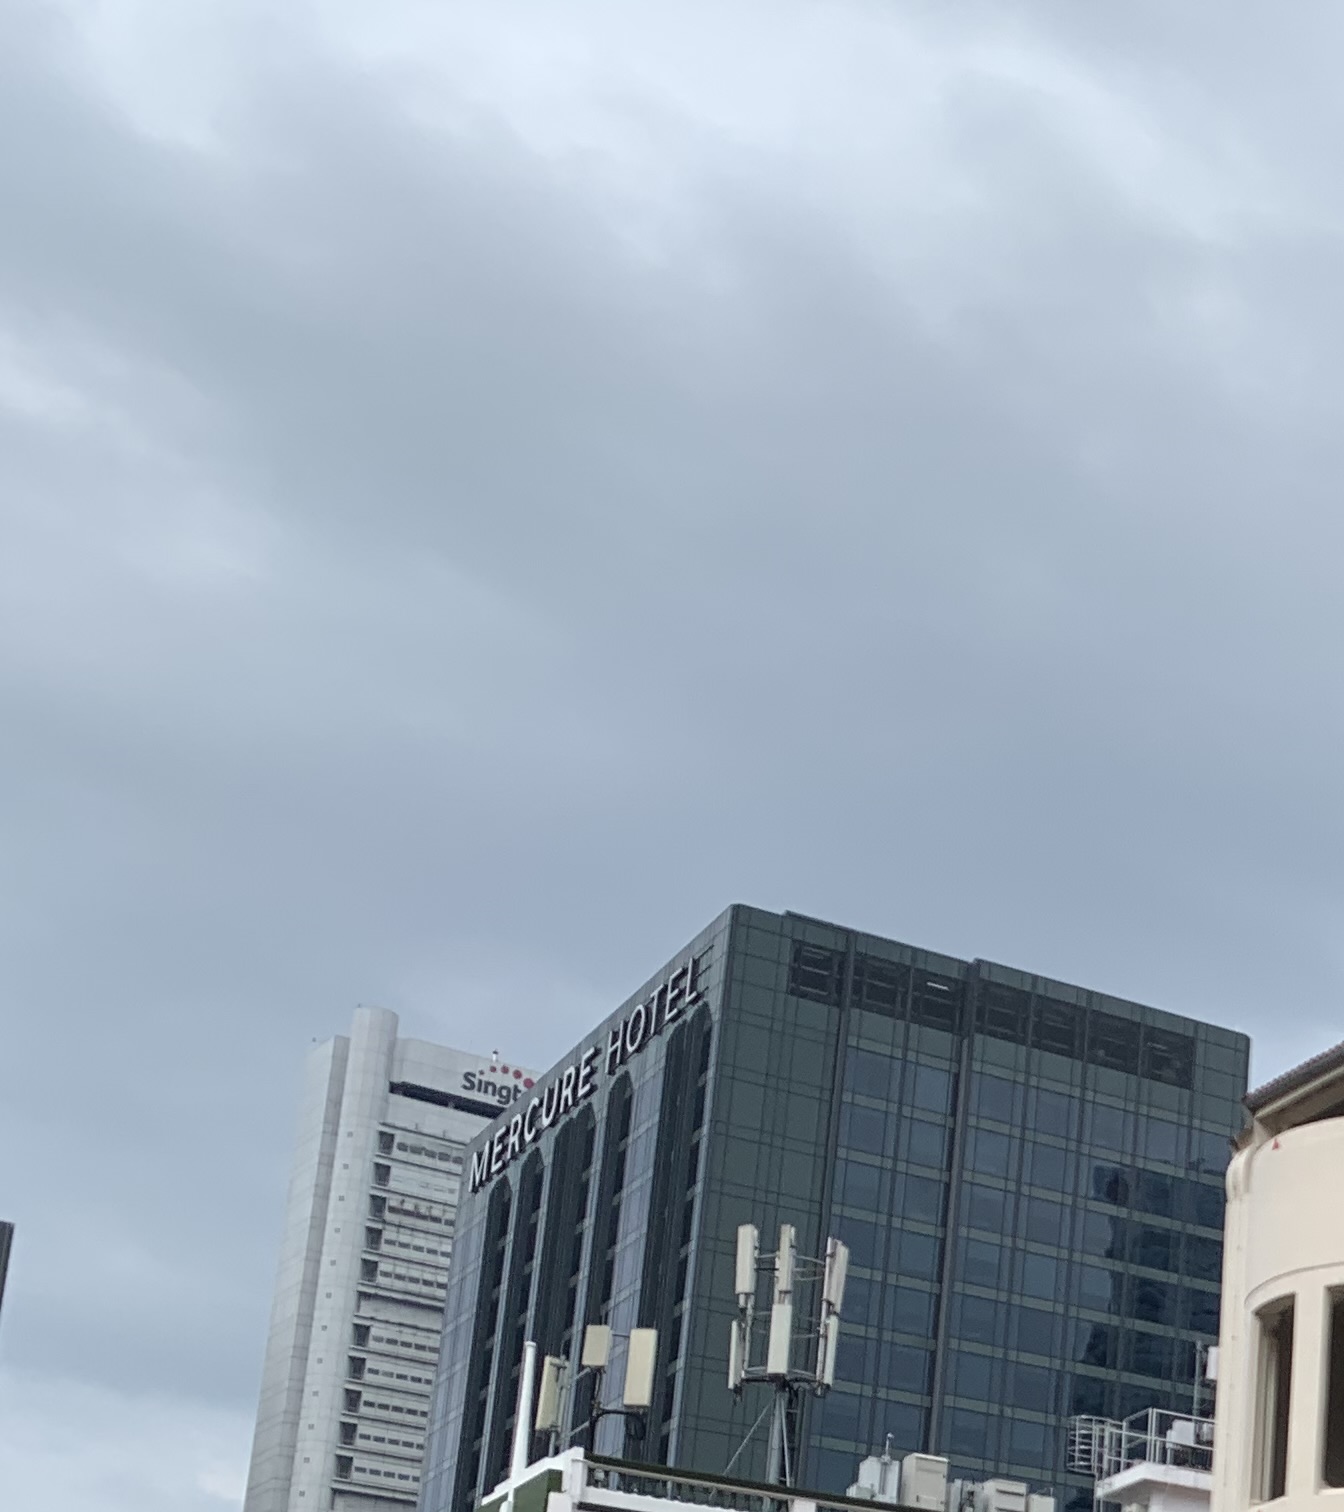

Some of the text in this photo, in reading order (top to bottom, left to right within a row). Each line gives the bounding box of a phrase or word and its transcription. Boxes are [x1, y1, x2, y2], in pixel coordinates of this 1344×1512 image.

[461, 1068, 522, 1107] Singt
[468, 957, 699, 1193] MERCURE HOTEL
